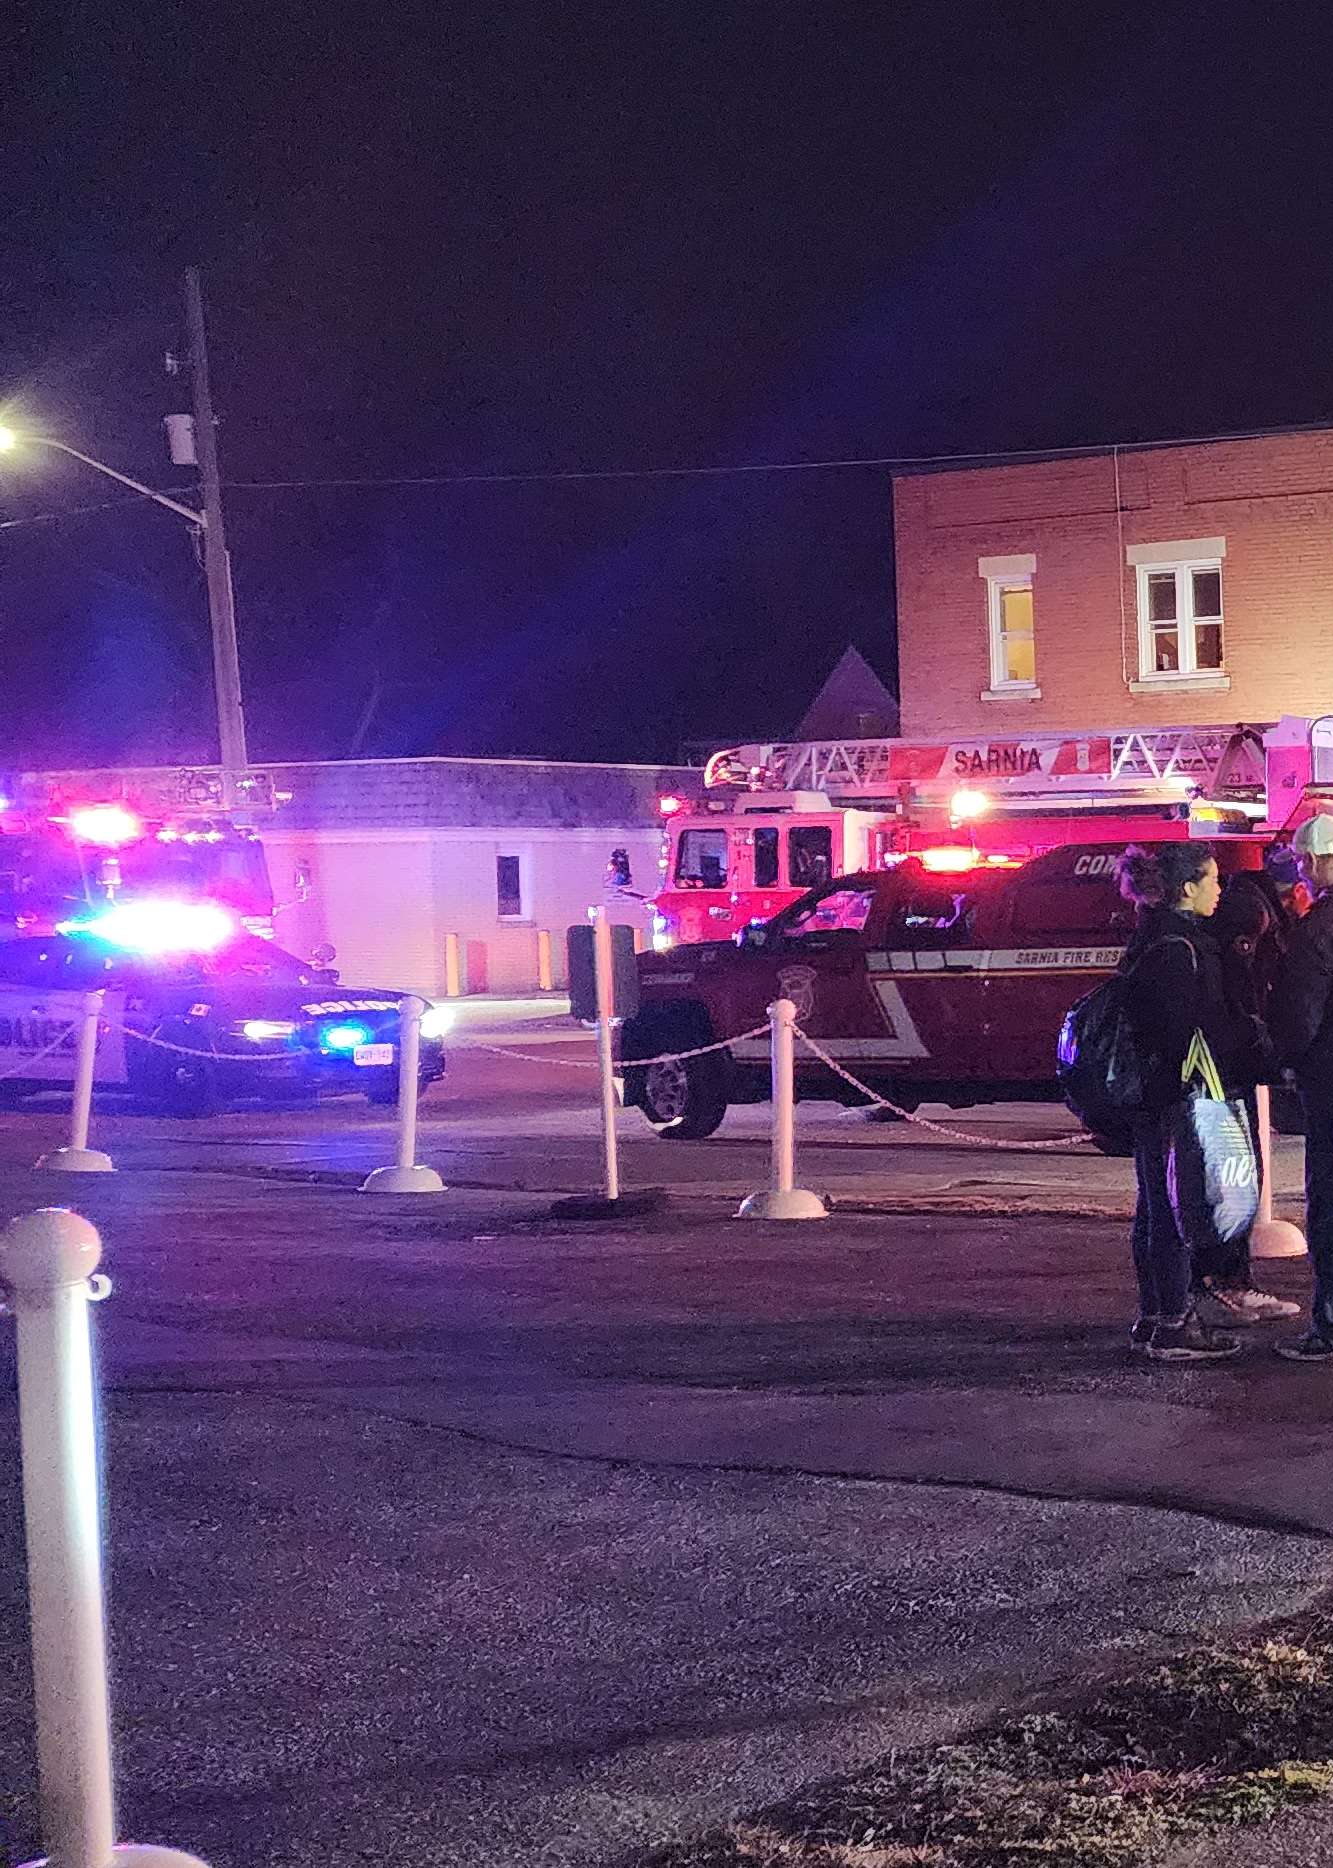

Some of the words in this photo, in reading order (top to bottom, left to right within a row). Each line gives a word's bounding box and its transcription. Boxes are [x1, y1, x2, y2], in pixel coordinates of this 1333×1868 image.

[954, 747, 1042, 775] SARNIA
[1016, 953, 1059, 964] SARNIA
[1063, 952, 1092, 963] FIRE
